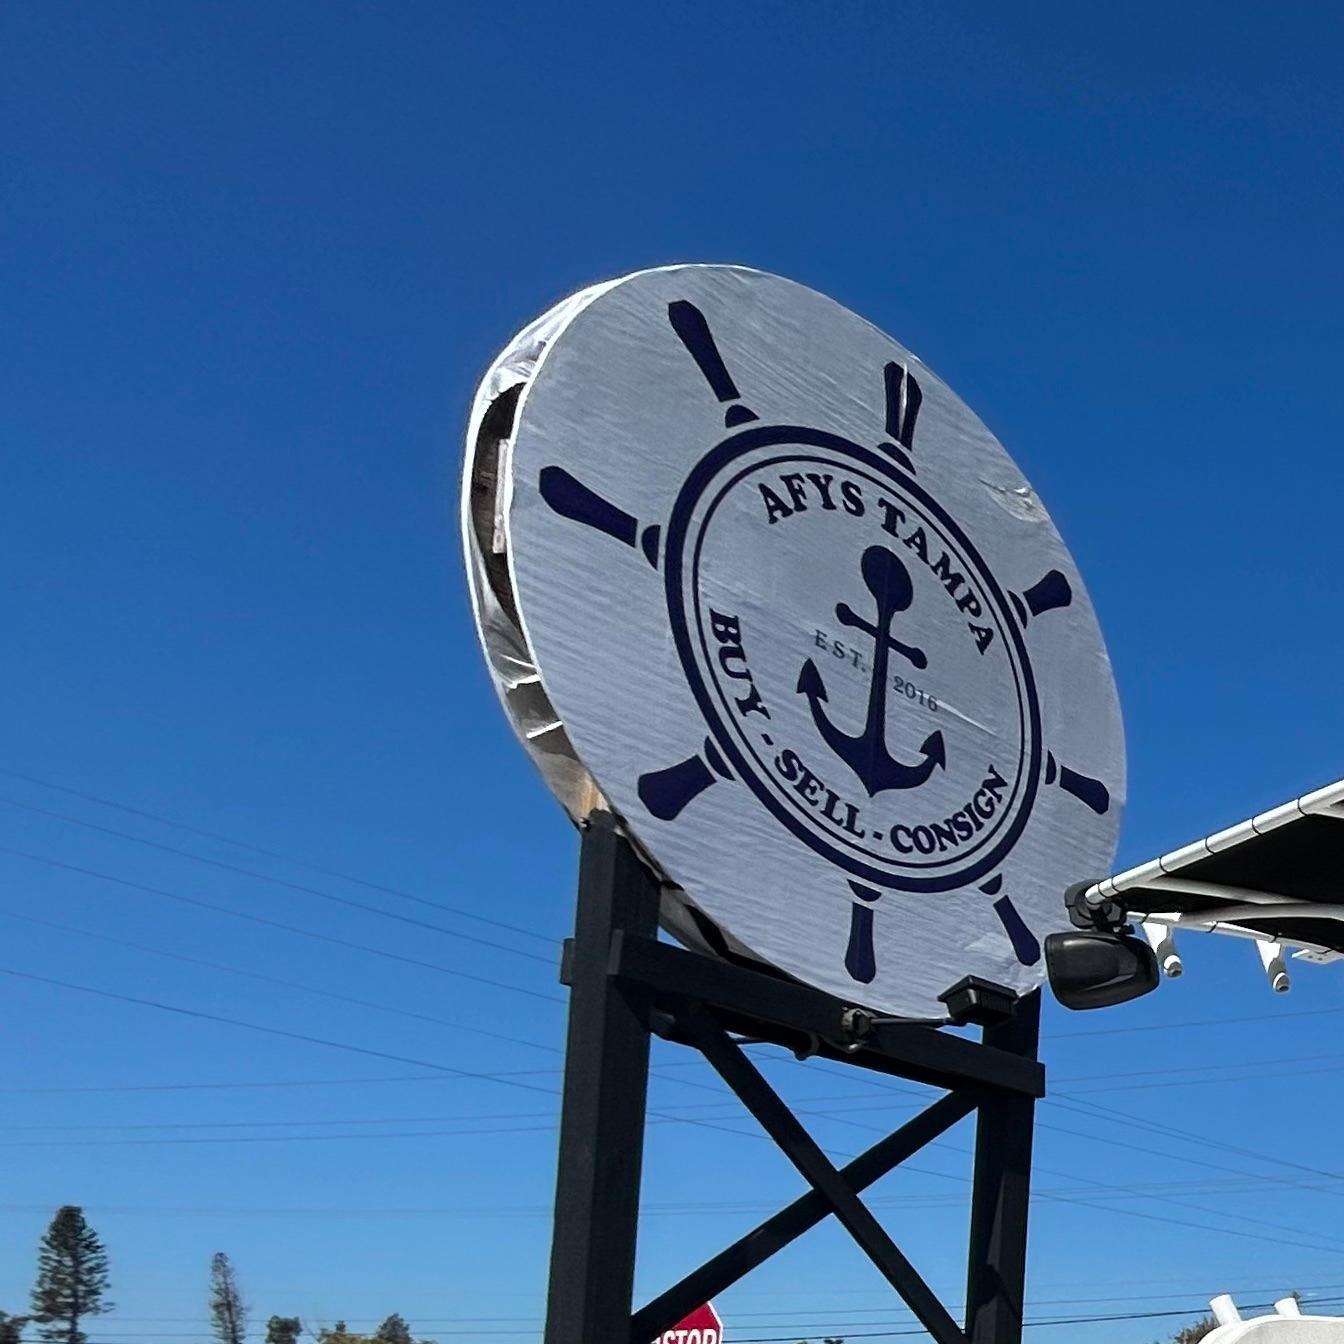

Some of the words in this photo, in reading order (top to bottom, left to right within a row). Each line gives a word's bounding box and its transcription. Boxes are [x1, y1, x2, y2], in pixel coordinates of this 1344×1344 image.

[757, 472, 866, 525] AFYS
[877, 497, 995, 656] TAMPA
[708, 607, 772, 721] BUY
[773, 749, 866, 840] SELL
[889, 763, 1009, 855] CONSIGN
[813, 628, 868, 673] EST.
[892, 675, 939, 713] 2016
